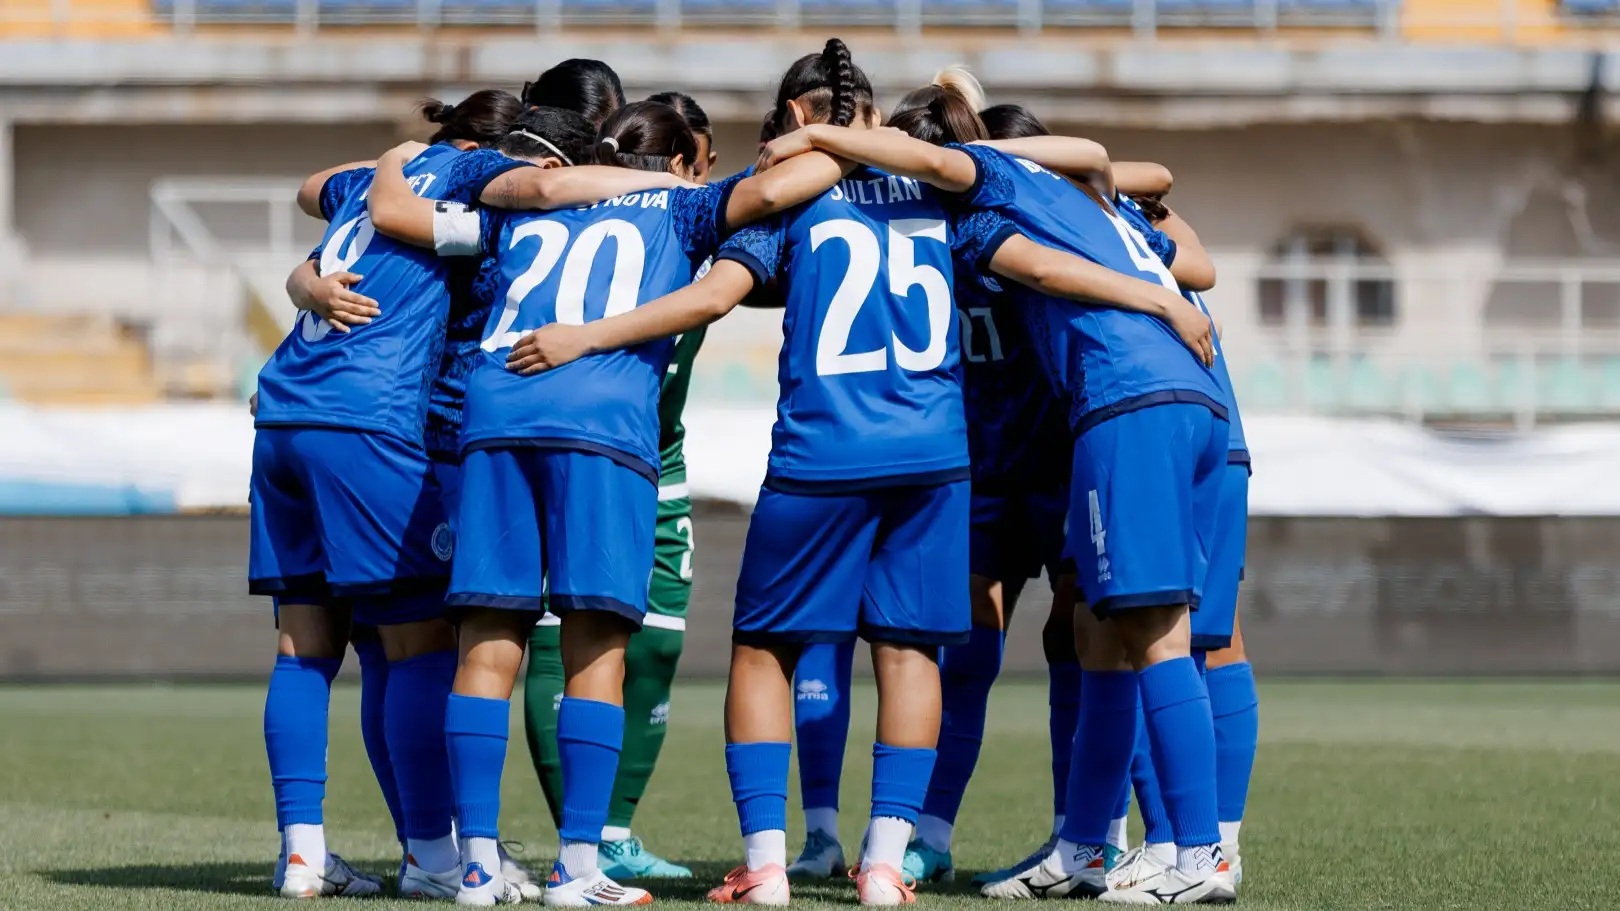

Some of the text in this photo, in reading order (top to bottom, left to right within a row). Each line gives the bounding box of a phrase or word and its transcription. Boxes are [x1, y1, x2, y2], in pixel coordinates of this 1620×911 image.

[830, 175, 922, 205] SULTAN
[480, 218, 646, 353] 20
[810, 218, 951, 377] 25
[1088, 489, 1107, 557] 4
